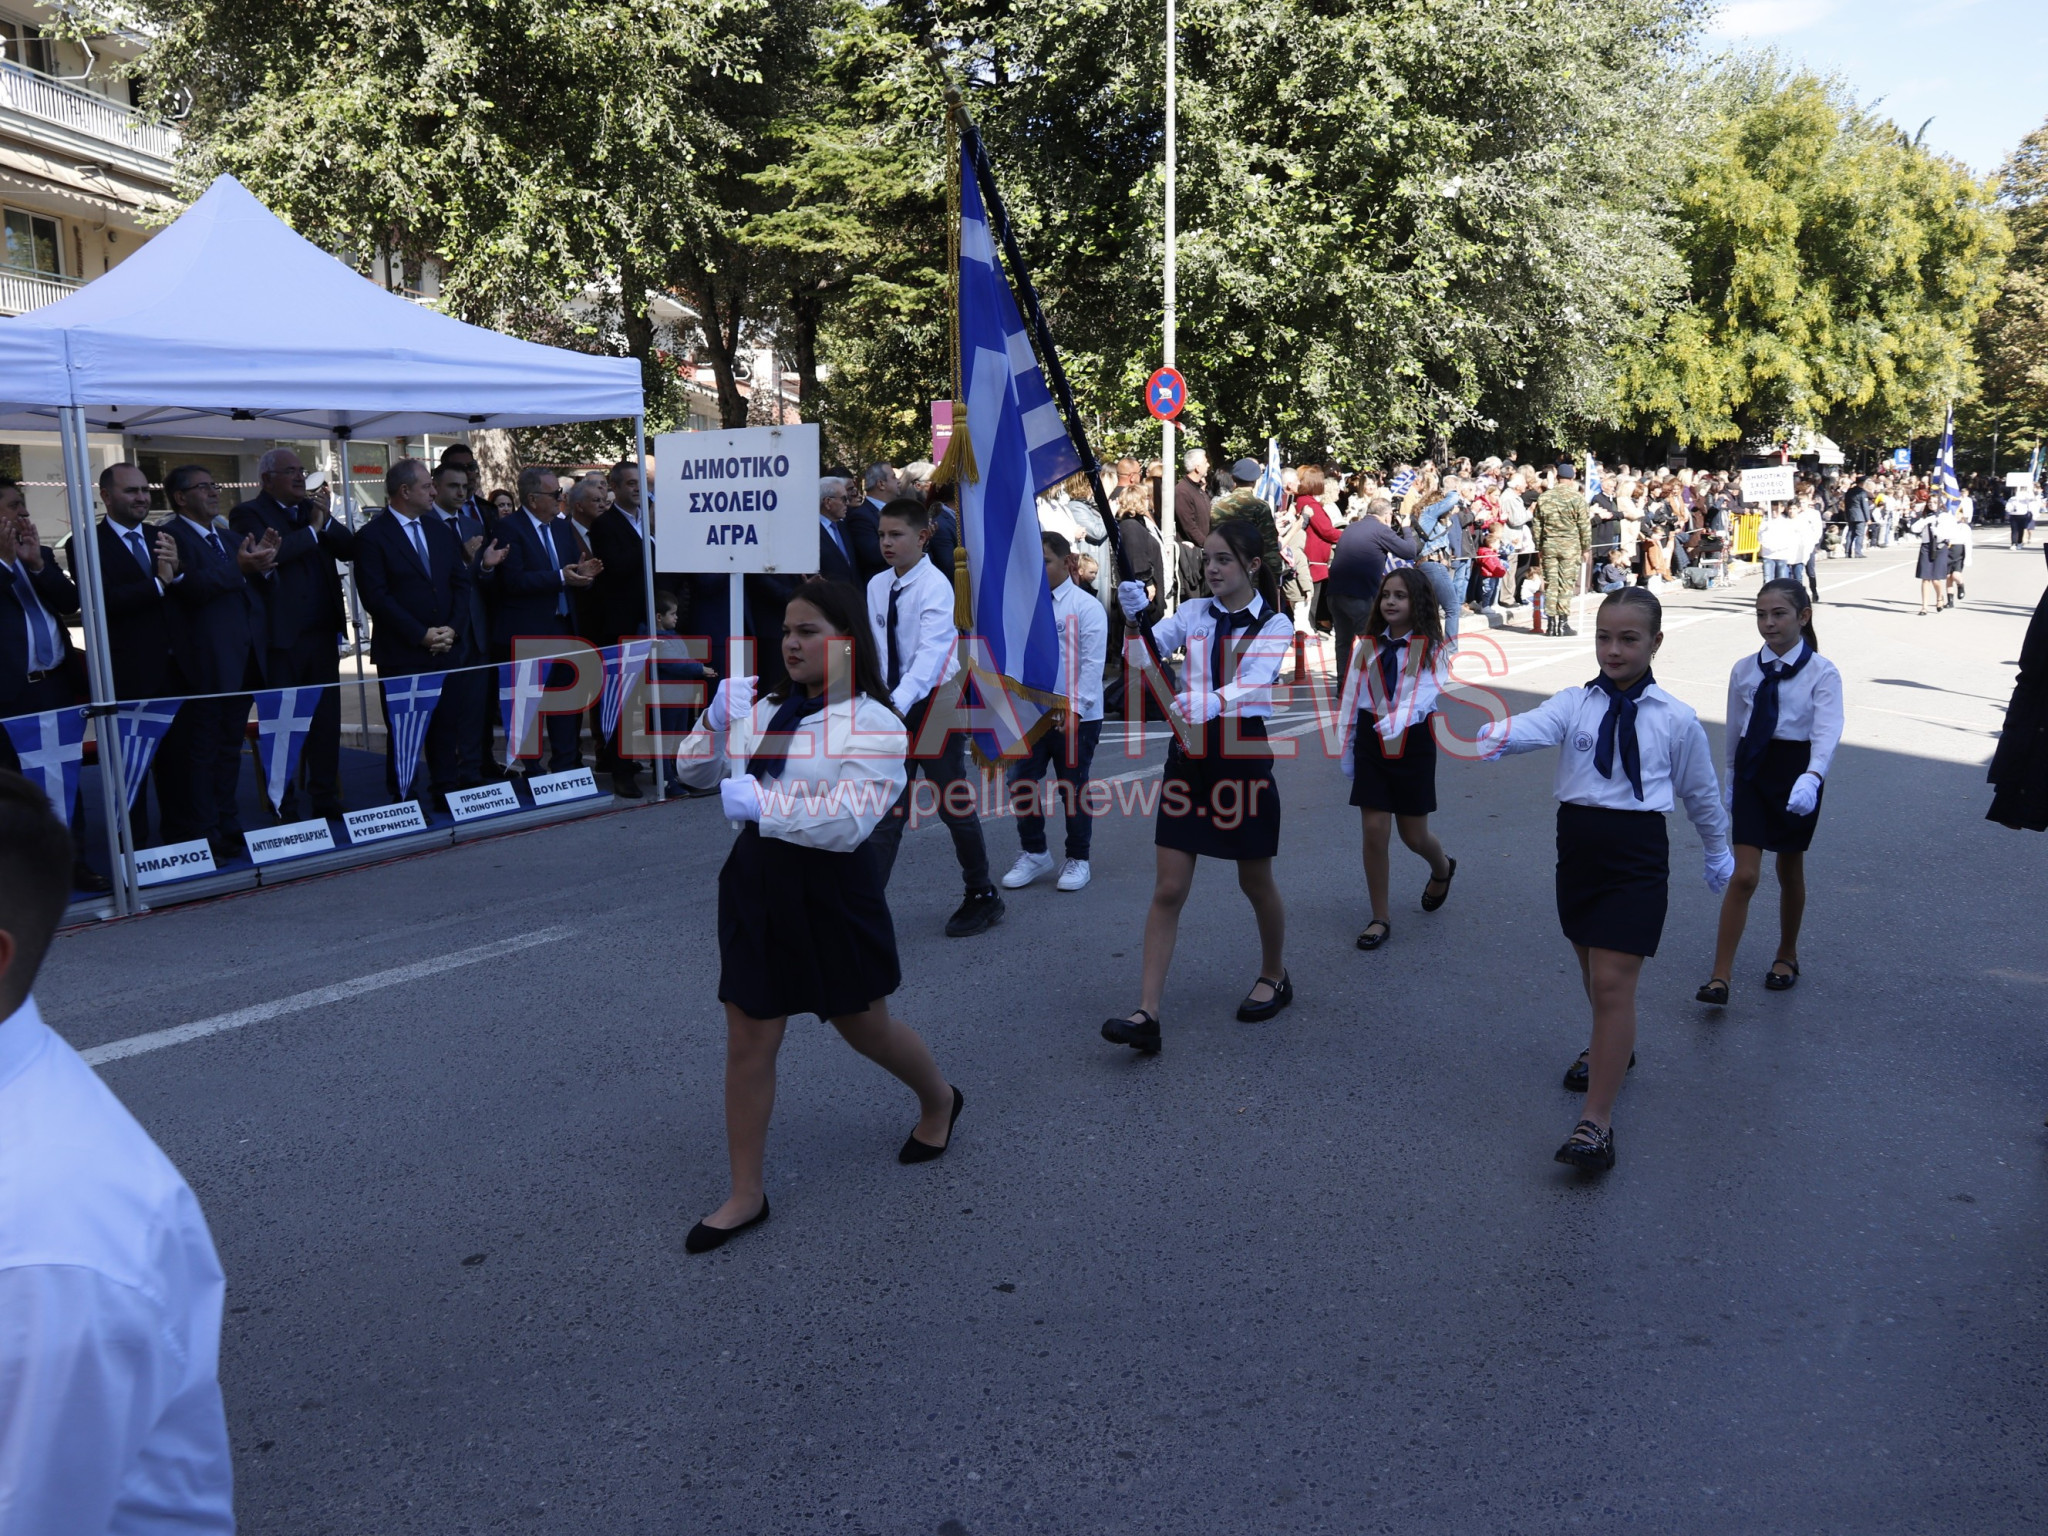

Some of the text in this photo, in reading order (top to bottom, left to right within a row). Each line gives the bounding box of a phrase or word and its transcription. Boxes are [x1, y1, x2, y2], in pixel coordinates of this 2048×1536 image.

[681, 455, 789, 480] ΔΗΜΟΤΙΚΟ
[689, 489, 778, 513] ΣΧΟΛΕΙΟ
[706, 524, 758, 545] ΑΓΡΑ
[460, 787, 502, 803] ΠΡΟΕΔΡΟΣ
[533, 776, 593, 796] ΒΟΥΛΕΥΤΕΣ
[348, 805, 417, 825] ΕΚΠΡΟΣΩΠΟΣ
[465, 796, 516, 815] ΚΟΙΝΟΤΗΤΑΣ
[353, 817, 421, 838] ΚΥΒΕΡΝΗΣΗΣ
[251, 828, 329, 853] ΑΝΤΙΠΕΡΙΦΕΡΕΙΑΡΧΗΣ
[136, 850, 210, 874] ΗΜΑΡΧΟΣ
